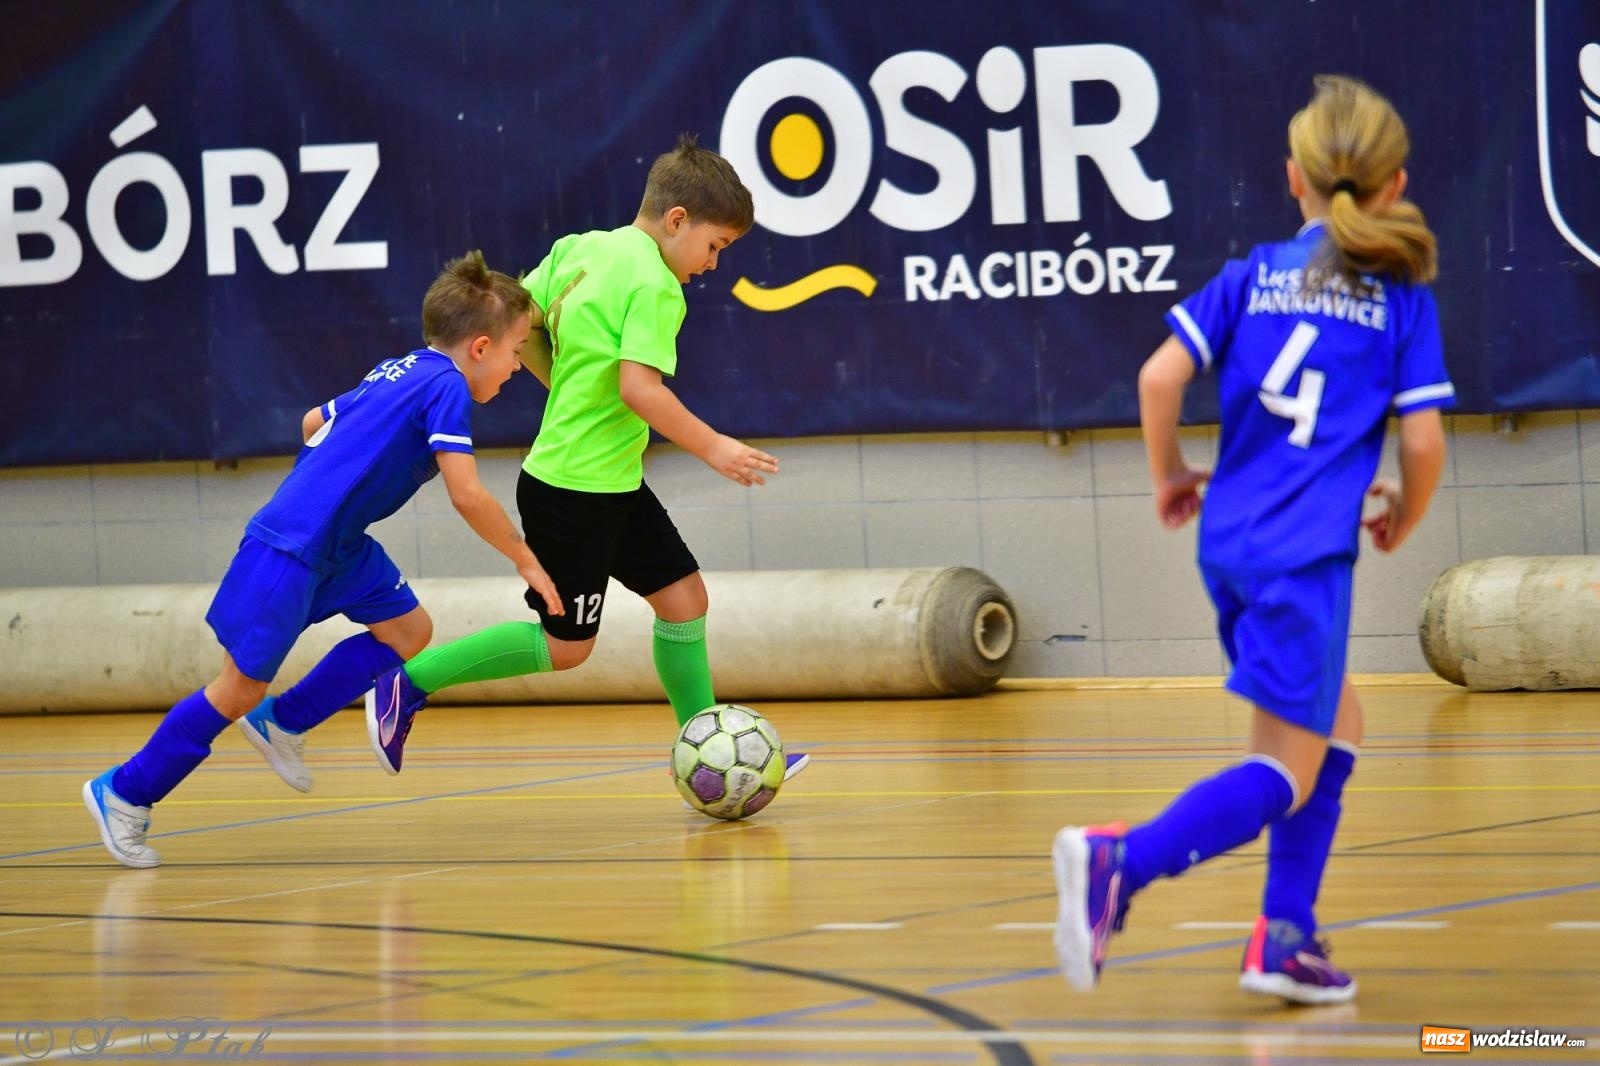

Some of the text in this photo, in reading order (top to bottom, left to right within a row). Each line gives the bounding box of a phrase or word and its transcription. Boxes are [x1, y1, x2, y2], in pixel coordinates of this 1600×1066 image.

[0, 104, 389, 287] BÓRZ
[719, 44, 1173, 236] OSiR
[904, 232, 1177, 302] RACIBÓRZ
[1257, 320, 1327, 450] 4
[574, 593, 602, 625] 12
